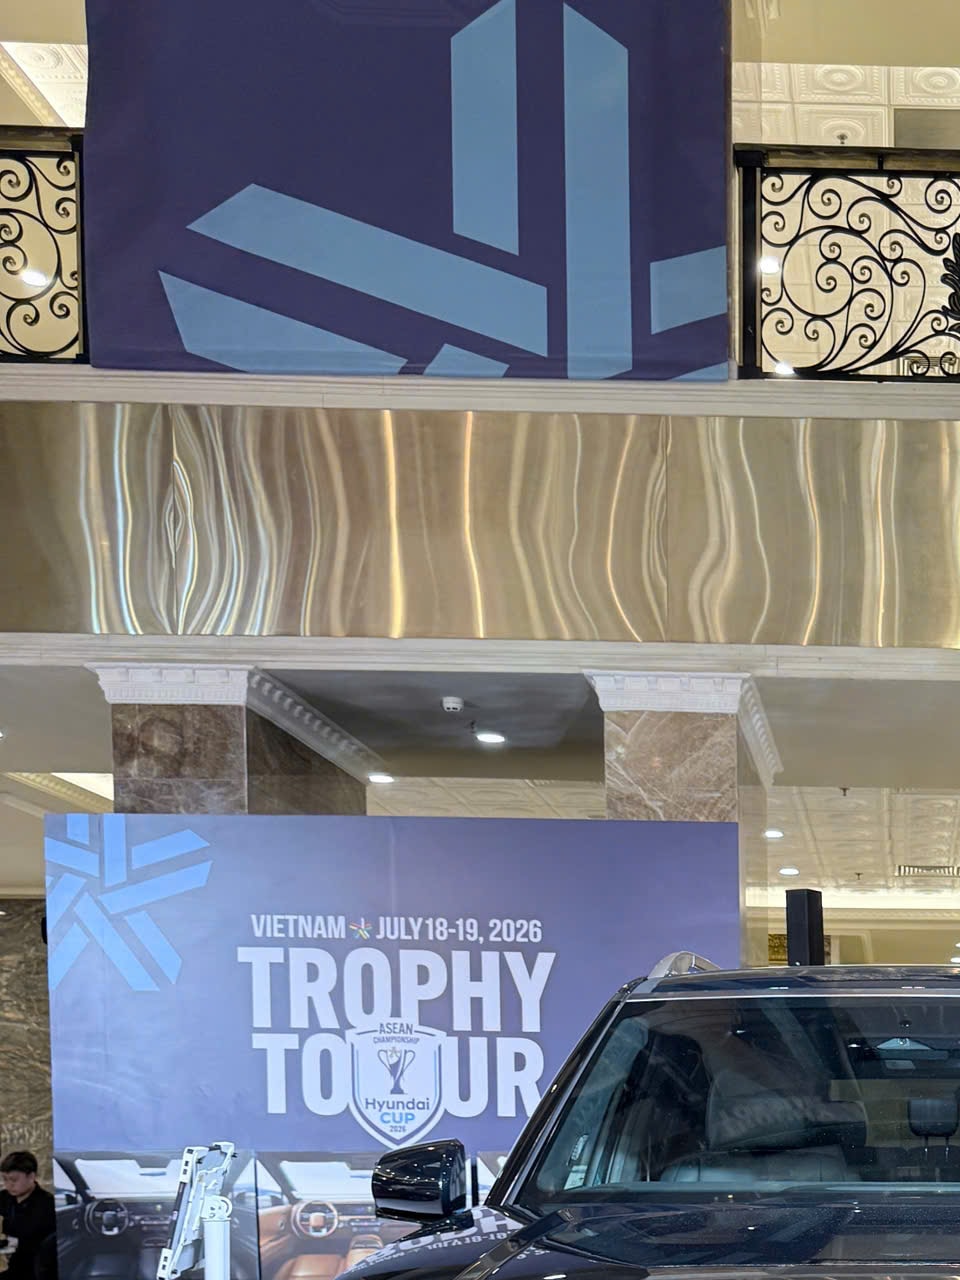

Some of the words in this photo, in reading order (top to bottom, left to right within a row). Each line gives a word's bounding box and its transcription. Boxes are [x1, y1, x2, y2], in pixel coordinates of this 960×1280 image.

[250, 914, 346, 938] VIETNAM
[375, 916, 423, 940] JULY
[424, 917, 484, 944] 18-19,
[488, 918, 542, 943] 2026
[237, 946, 556, 1032] TROPHY
[379, 1022, 414, 1034] ASEAN
[373, 1036, 420, 1044] CHAMPIONSHIP
[251, 1032, 545, 1117] TOUR
[365, 1097, 430, 1112] Hyundai
[380, 1112, 415, 1124] CUP
